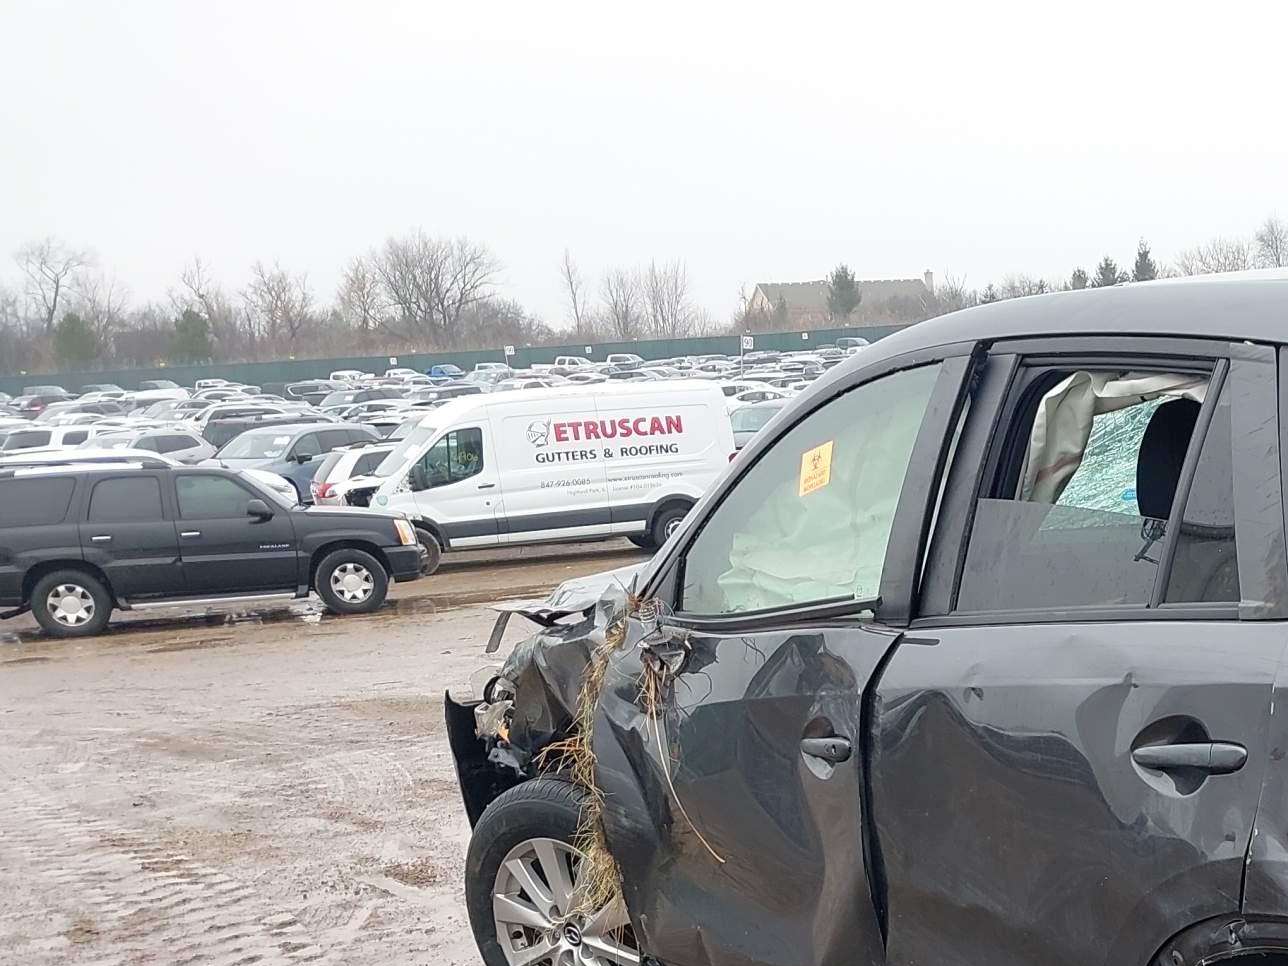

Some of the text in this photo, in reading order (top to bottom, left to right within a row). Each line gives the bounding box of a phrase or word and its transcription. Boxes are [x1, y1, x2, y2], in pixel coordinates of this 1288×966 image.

[553, 415, 683, 442] ETRUSCAN
[535, 443, 679, 463] GUTTERS & ROOFING
